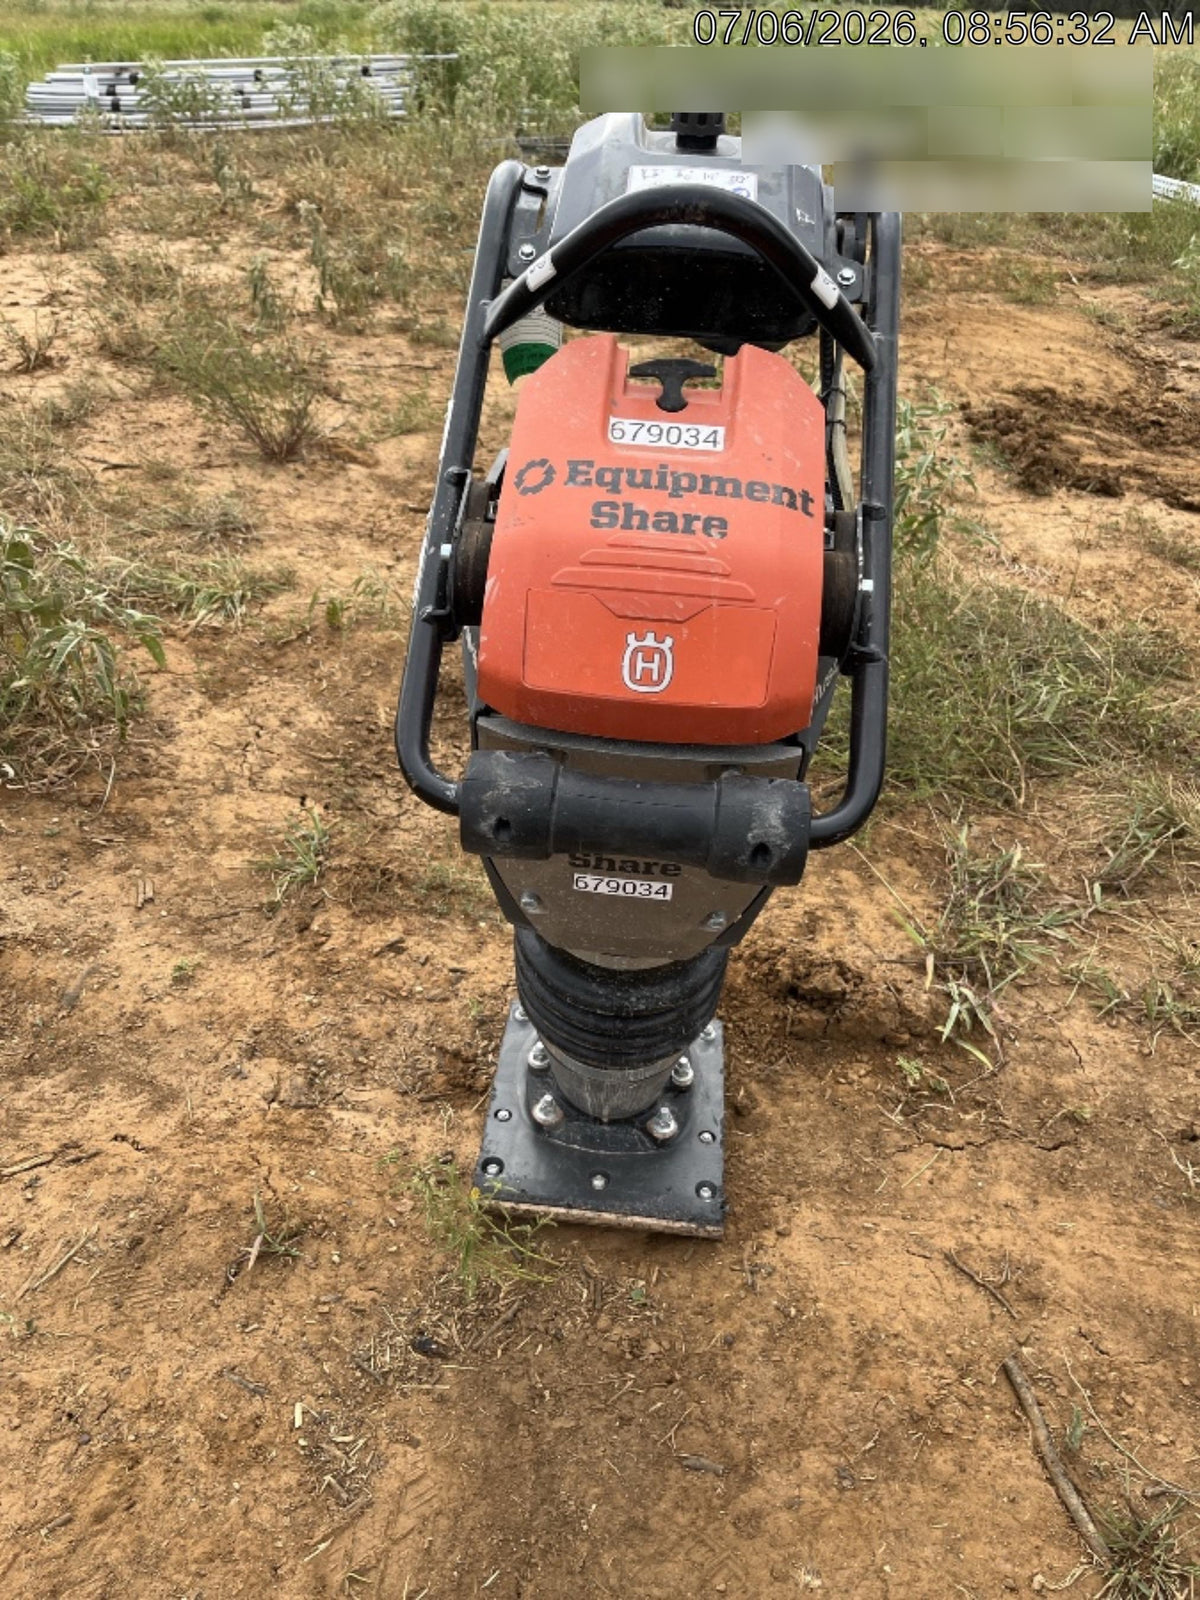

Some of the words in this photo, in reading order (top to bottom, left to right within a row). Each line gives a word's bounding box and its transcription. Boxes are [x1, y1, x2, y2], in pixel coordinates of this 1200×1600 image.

[610, 421, 720, 448] 679034
[565, 460, 814, 517] Equipment
[590, 500, 729, 539] Share
[635, 651, 660, 682] H
[575, 876, 668, 898] 679034
